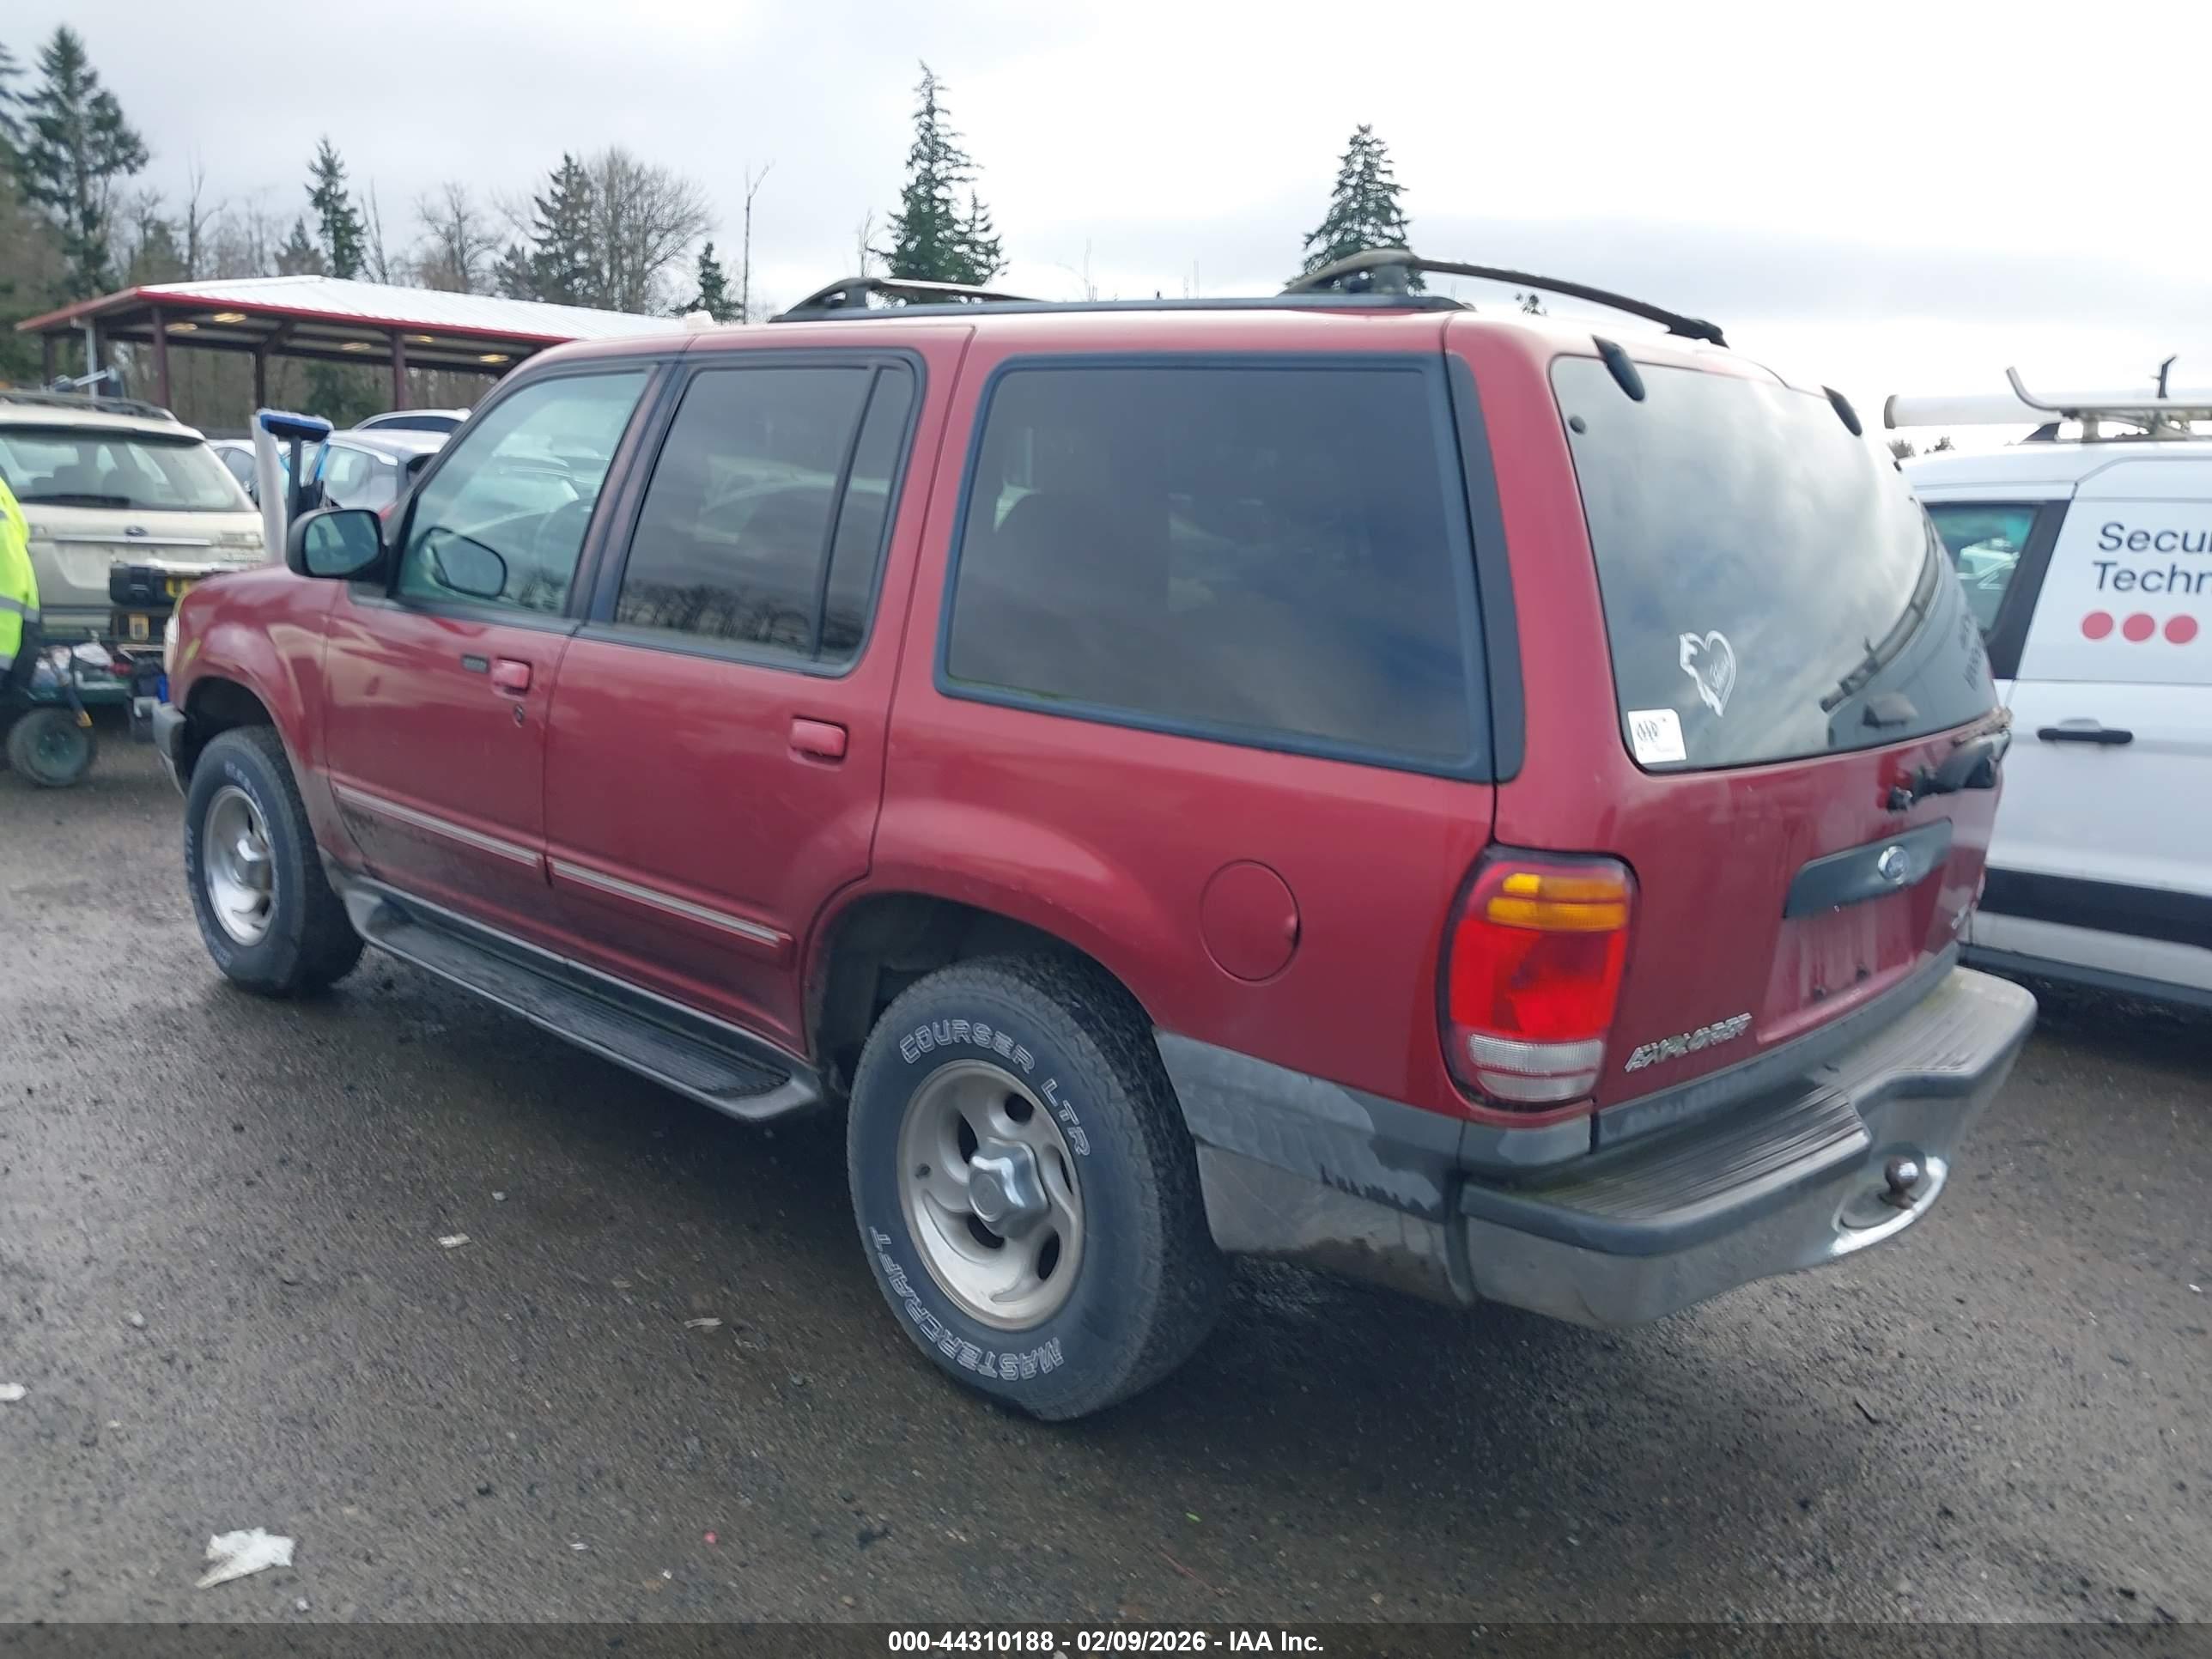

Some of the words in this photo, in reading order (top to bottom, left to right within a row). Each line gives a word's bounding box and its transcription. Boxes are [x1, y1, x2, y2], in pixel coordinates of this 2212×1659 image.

[2097, 521, 2212, 553] Secu
[899, 1018, 1036, 1075] COURSER
[1041, 1077, 1091, 1157] LTR
[868, 1225, 1065, 1382] MASTERCRAFT
